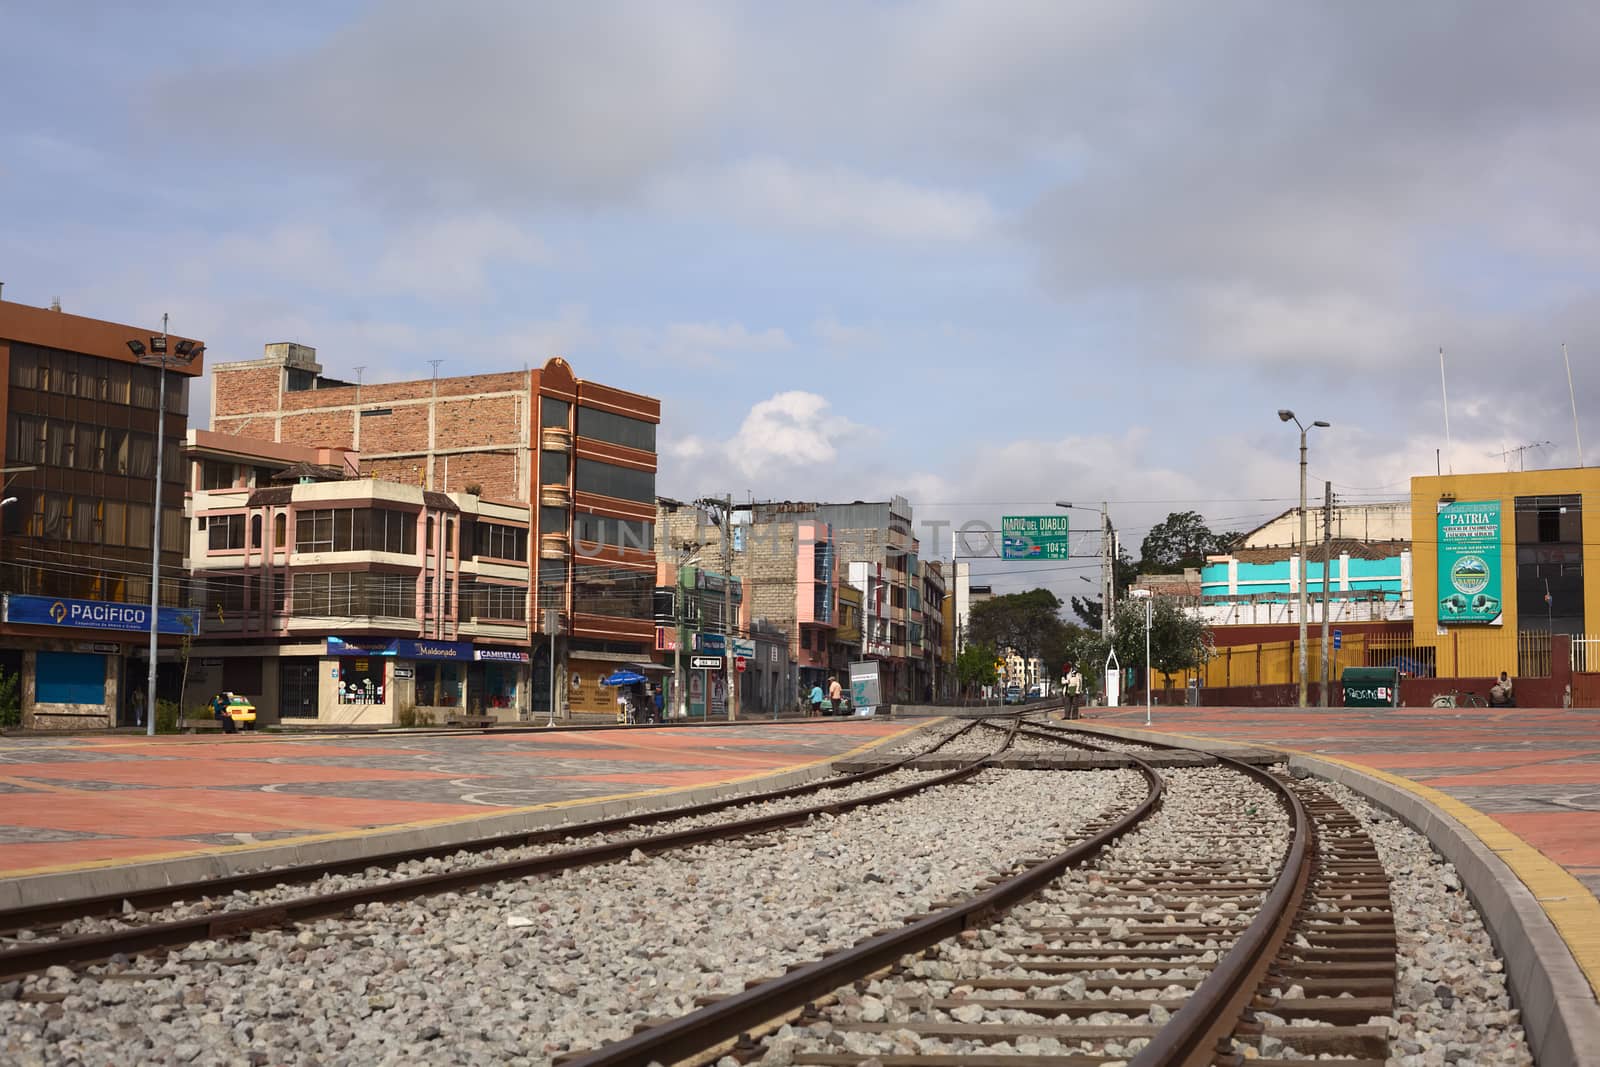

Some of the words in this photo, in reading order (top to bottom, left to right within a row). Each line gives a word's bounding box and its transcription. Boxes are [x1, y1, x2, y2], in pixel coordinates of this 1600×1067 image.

[1003, 518, 1025, 530] NARIZ
[1040, 518, 1067, 530] DIABLO
[1047, 542, 1059, 552] 104
[71, 604, 145, 623] PACÍFICO
[420, 648, 457, 657] Maldonado
[480, 650, 520, 659] CAMISETAS
